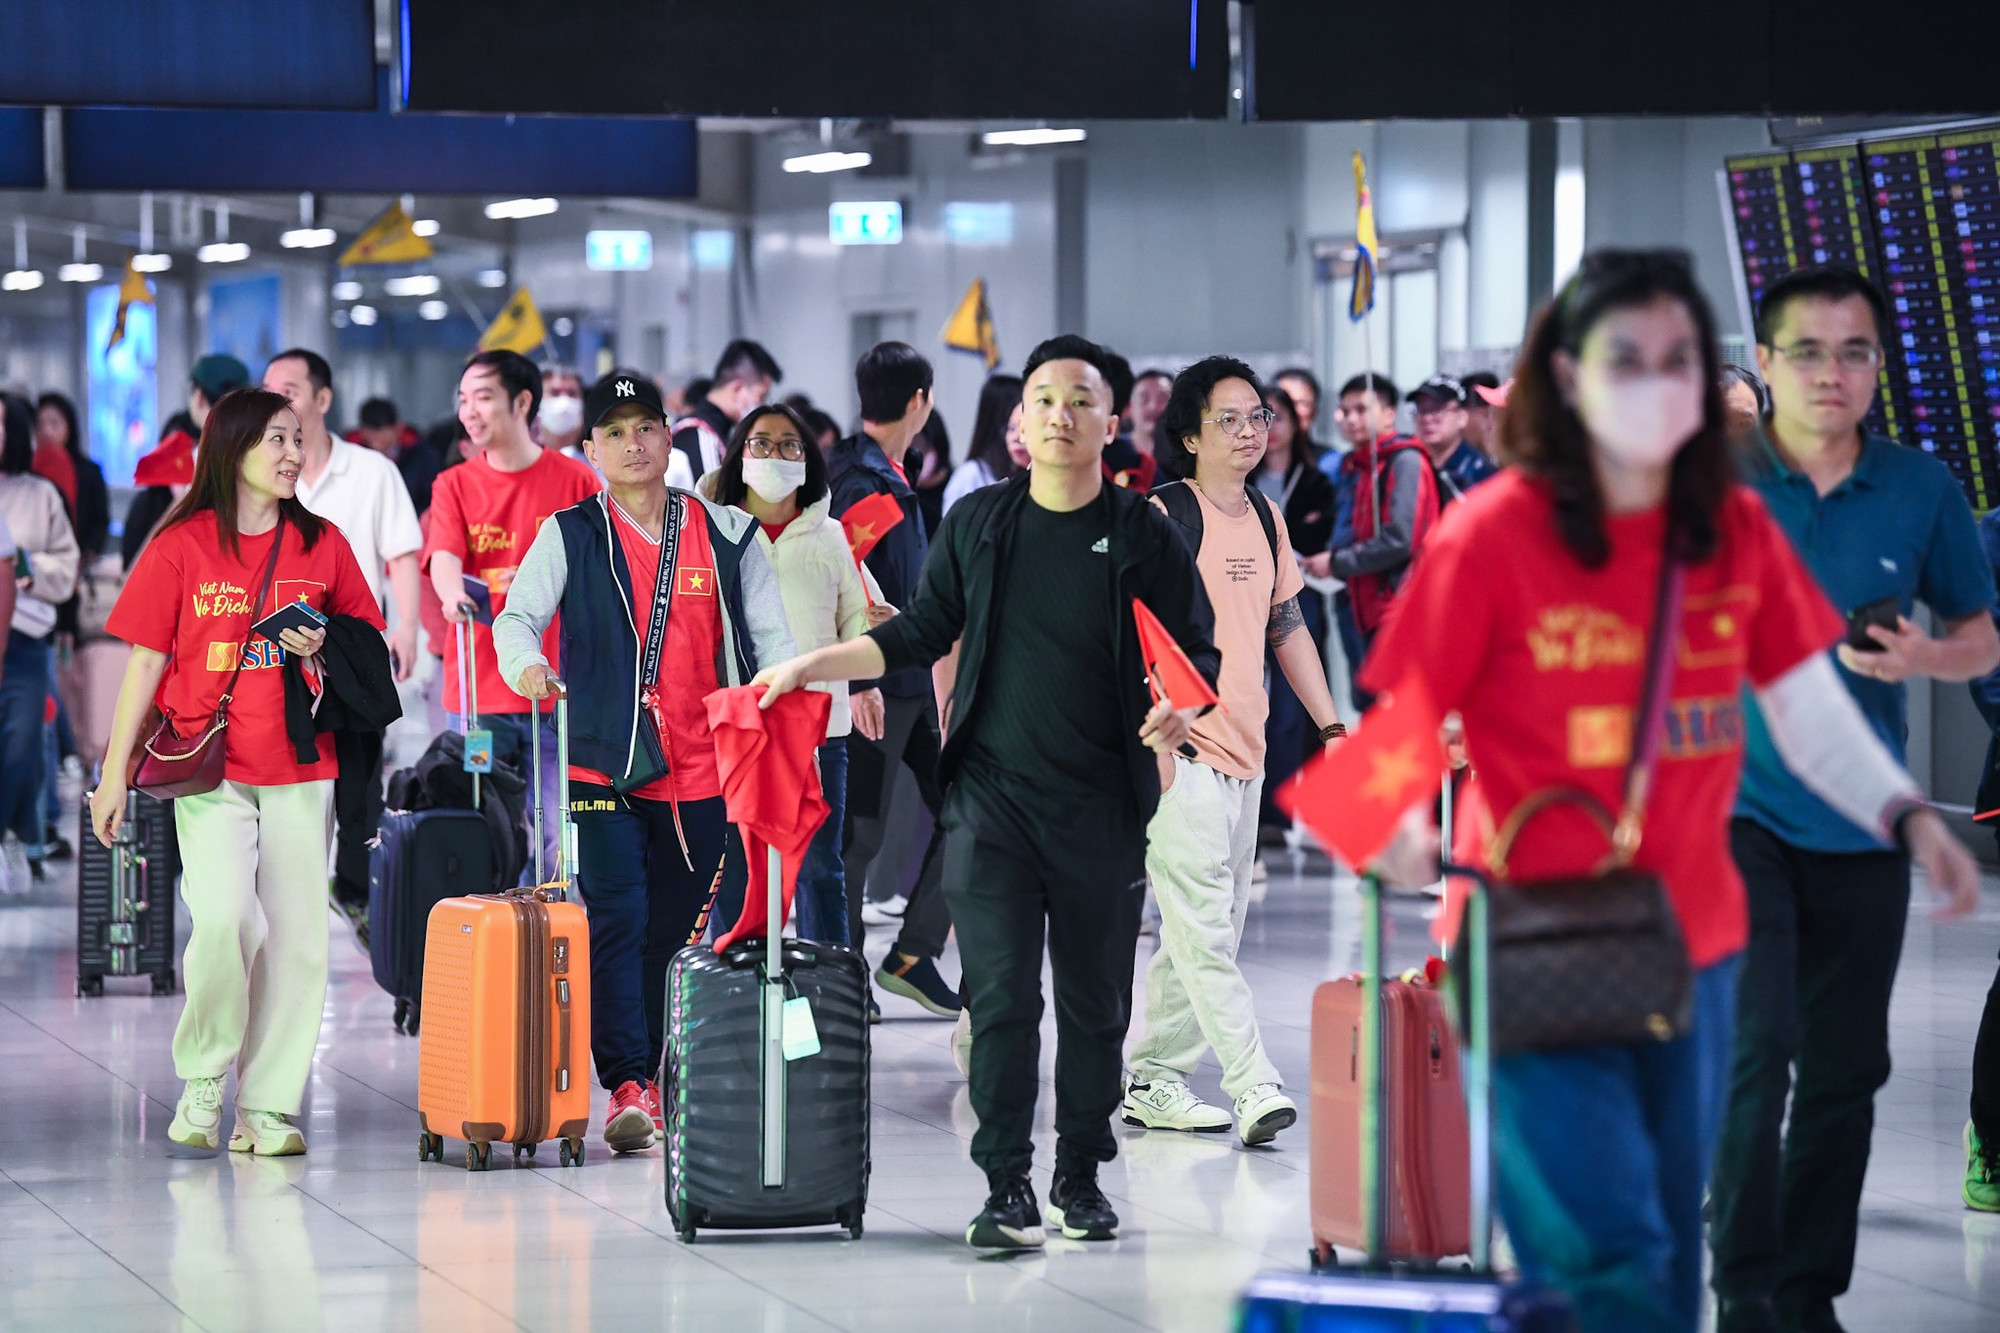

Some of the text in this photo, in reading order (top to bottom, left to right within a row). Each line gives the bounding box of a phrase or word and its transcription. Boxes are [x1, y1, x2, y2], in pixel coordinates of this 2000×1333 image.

[668, 522, 676, 540] POLO
[665, 542, 674, 560] HILLS
[660, 562, 671, 594] BEVERLY
[199, 581, 246, 597] Việt Nam
[192, 594, 211, 618] Vô
[654, 608, 664, 627] CLUB
[651, 629, 660, 648] POLO
[647, 650, 656, 670] HILLS
[570, 800, 616, 812] KELME
